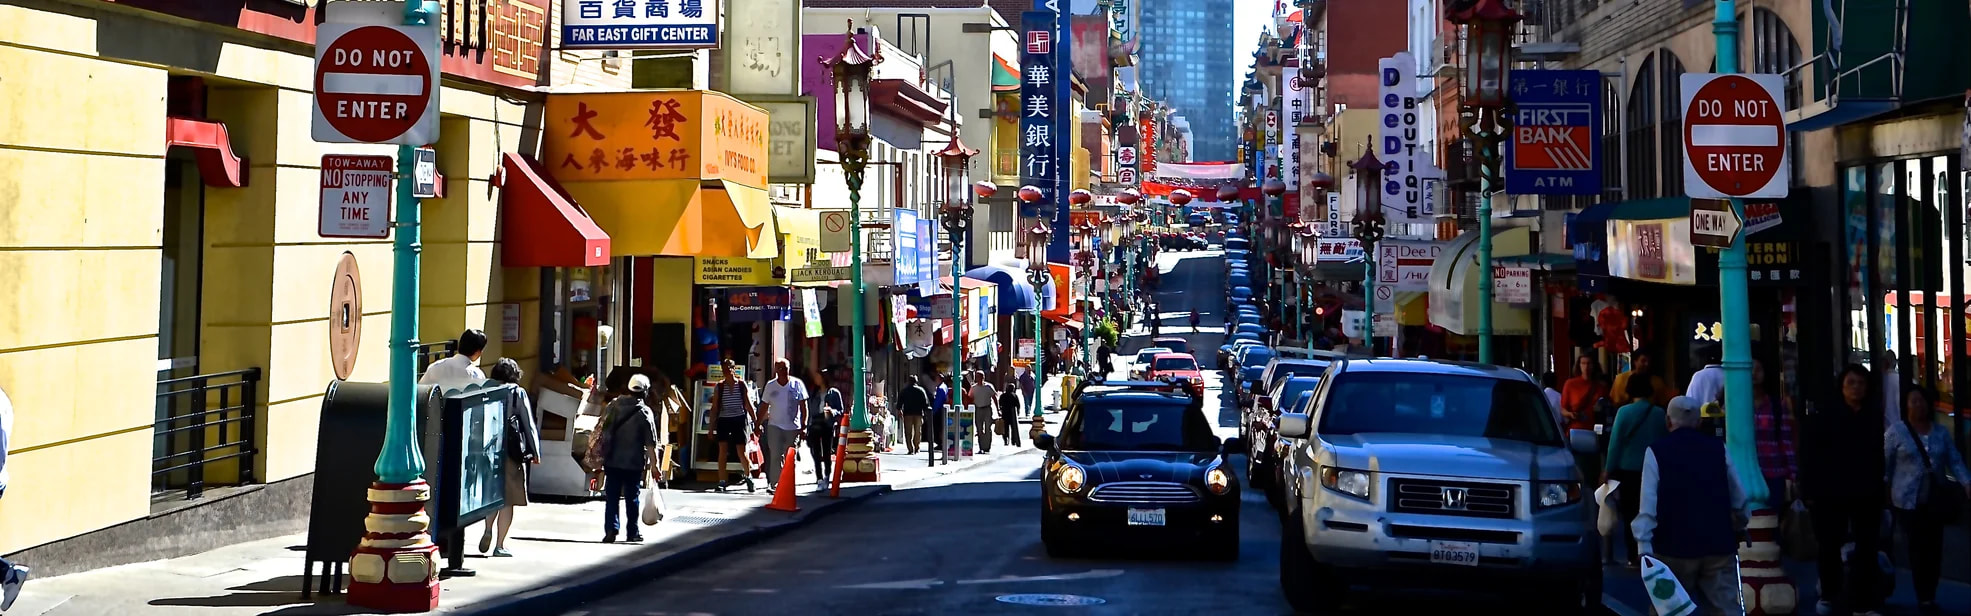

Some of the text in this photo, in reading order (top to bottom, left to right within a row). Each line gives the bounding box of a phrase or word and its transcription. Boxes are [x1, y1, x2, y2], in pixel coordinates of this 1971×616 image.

[572, 27, 709, 41] FAR EAST GIFT CENTER
[335, 48, 414, 68] DO NOT
[1513, 77, 1591, 97] 第一銀行
[336, 100, 408, 119] ENTER
[1519, 108, 1569, 126] FIRST
[1699, 99, 1769, 118] DO NOT
[1026, 64, 1050, 178] 華美銀行
[1519, 127, 1574, 144] BANK
[328, 158, 386, 169] TOW-AWAY
[1403, 97, 1418, 219] BOUTIQUE
[1707, 153, 1764, 172] ENTER
[323, 169, 388, 188] NO STOPPING
[1534, 176, 1574, 188] ATM
[342, 191, 369, 205] ANY
[341, 207, 370, 221] TIME
[1330, 196, 1338, 236] FLORS
[1695, 213, 1726, 232] ONE WAY
[1400, 245, 1426, 257] Dee
[1745, 253, 1788, 265] NION
[797, 269, 813, 277] JACK
[1495, 267, 1529, 278] NO PARKING
